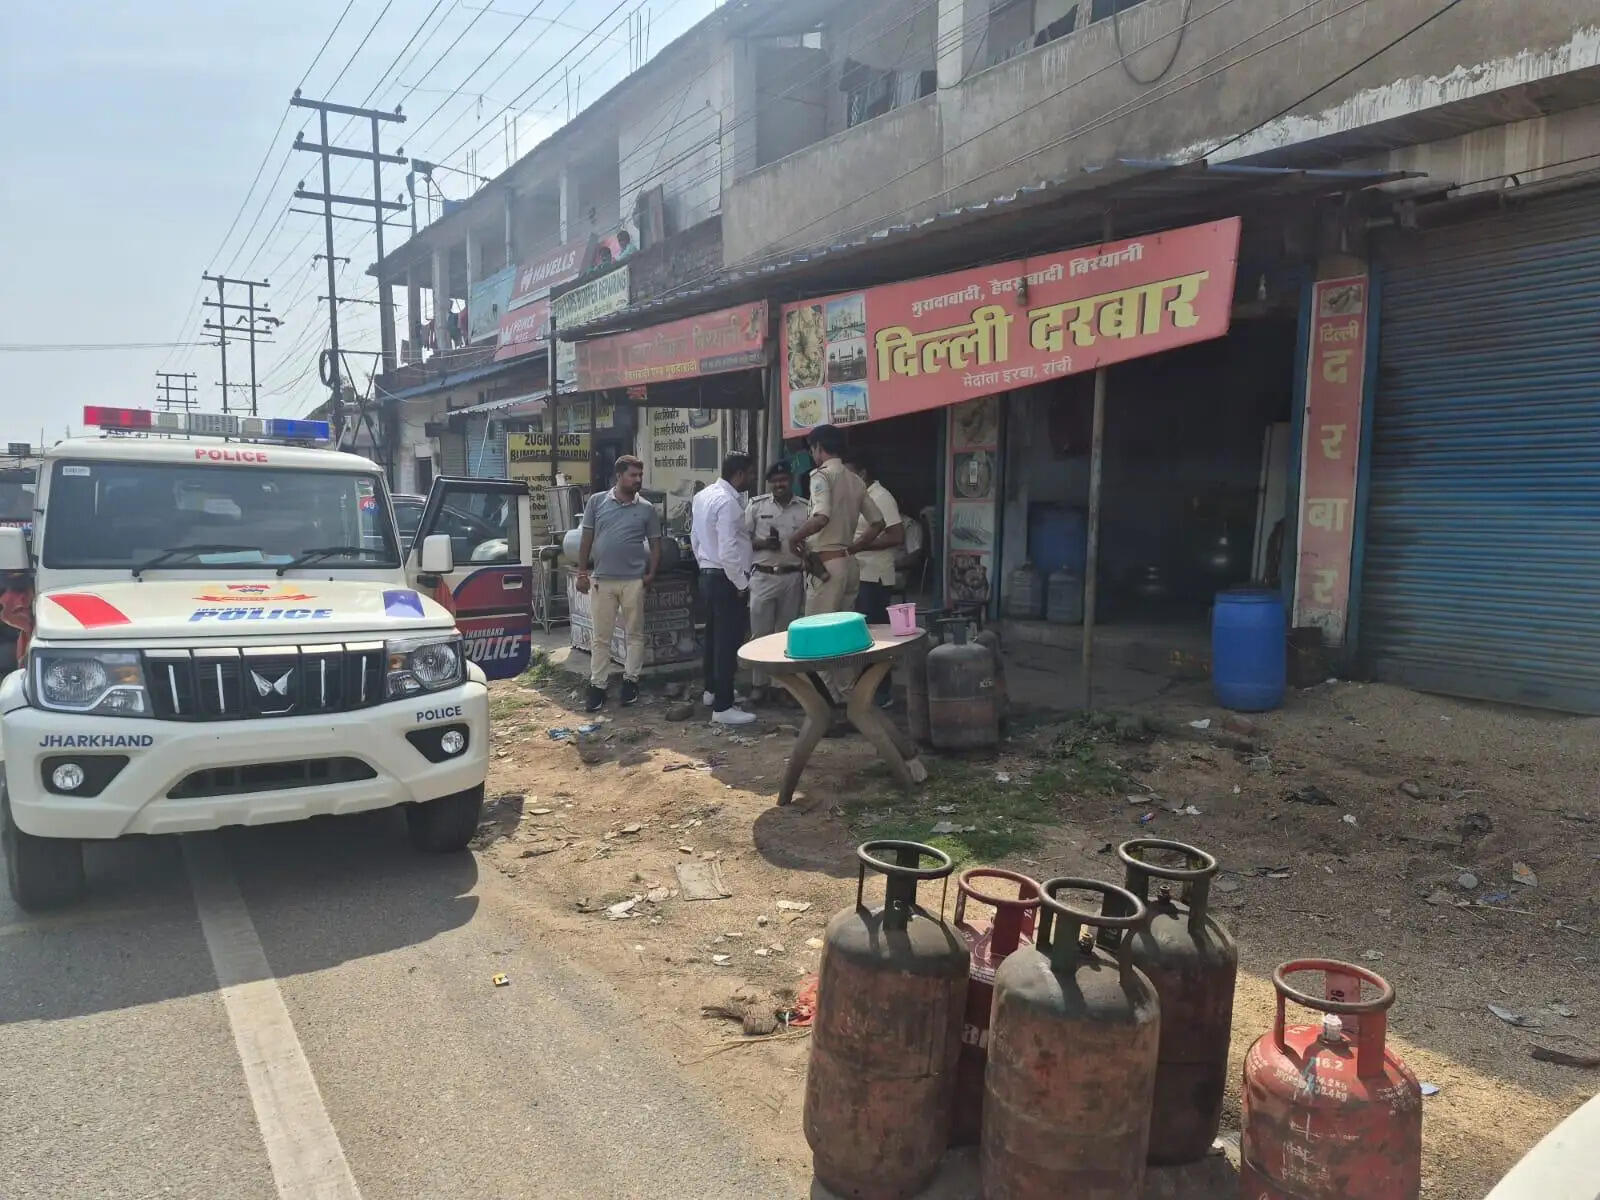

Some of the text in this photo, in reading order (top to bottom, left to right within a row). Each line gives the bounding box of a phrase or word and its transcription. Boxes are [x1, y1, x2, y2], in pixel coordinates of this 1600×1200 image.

[532, 250, 576, 285] HAVELLS
[1070, 243, 1145, 278] बिरयानी
[874, 271, 1210, 382] दिल्ली दरबार
[1320, 319, 1359, 344] दिल्ली
[525, 433, 581, 447] ZUGN CARS
[194, 447, 268, 464] POLICE
[188, 608, 334, 622] POLICE
[464, 634, 523, 662] POLICE
[416, 705, 462, 723] POLICE
[39, 735, 154, 748] JHARKHAND
[1315, 1056, 1345, 1071] 16.2
